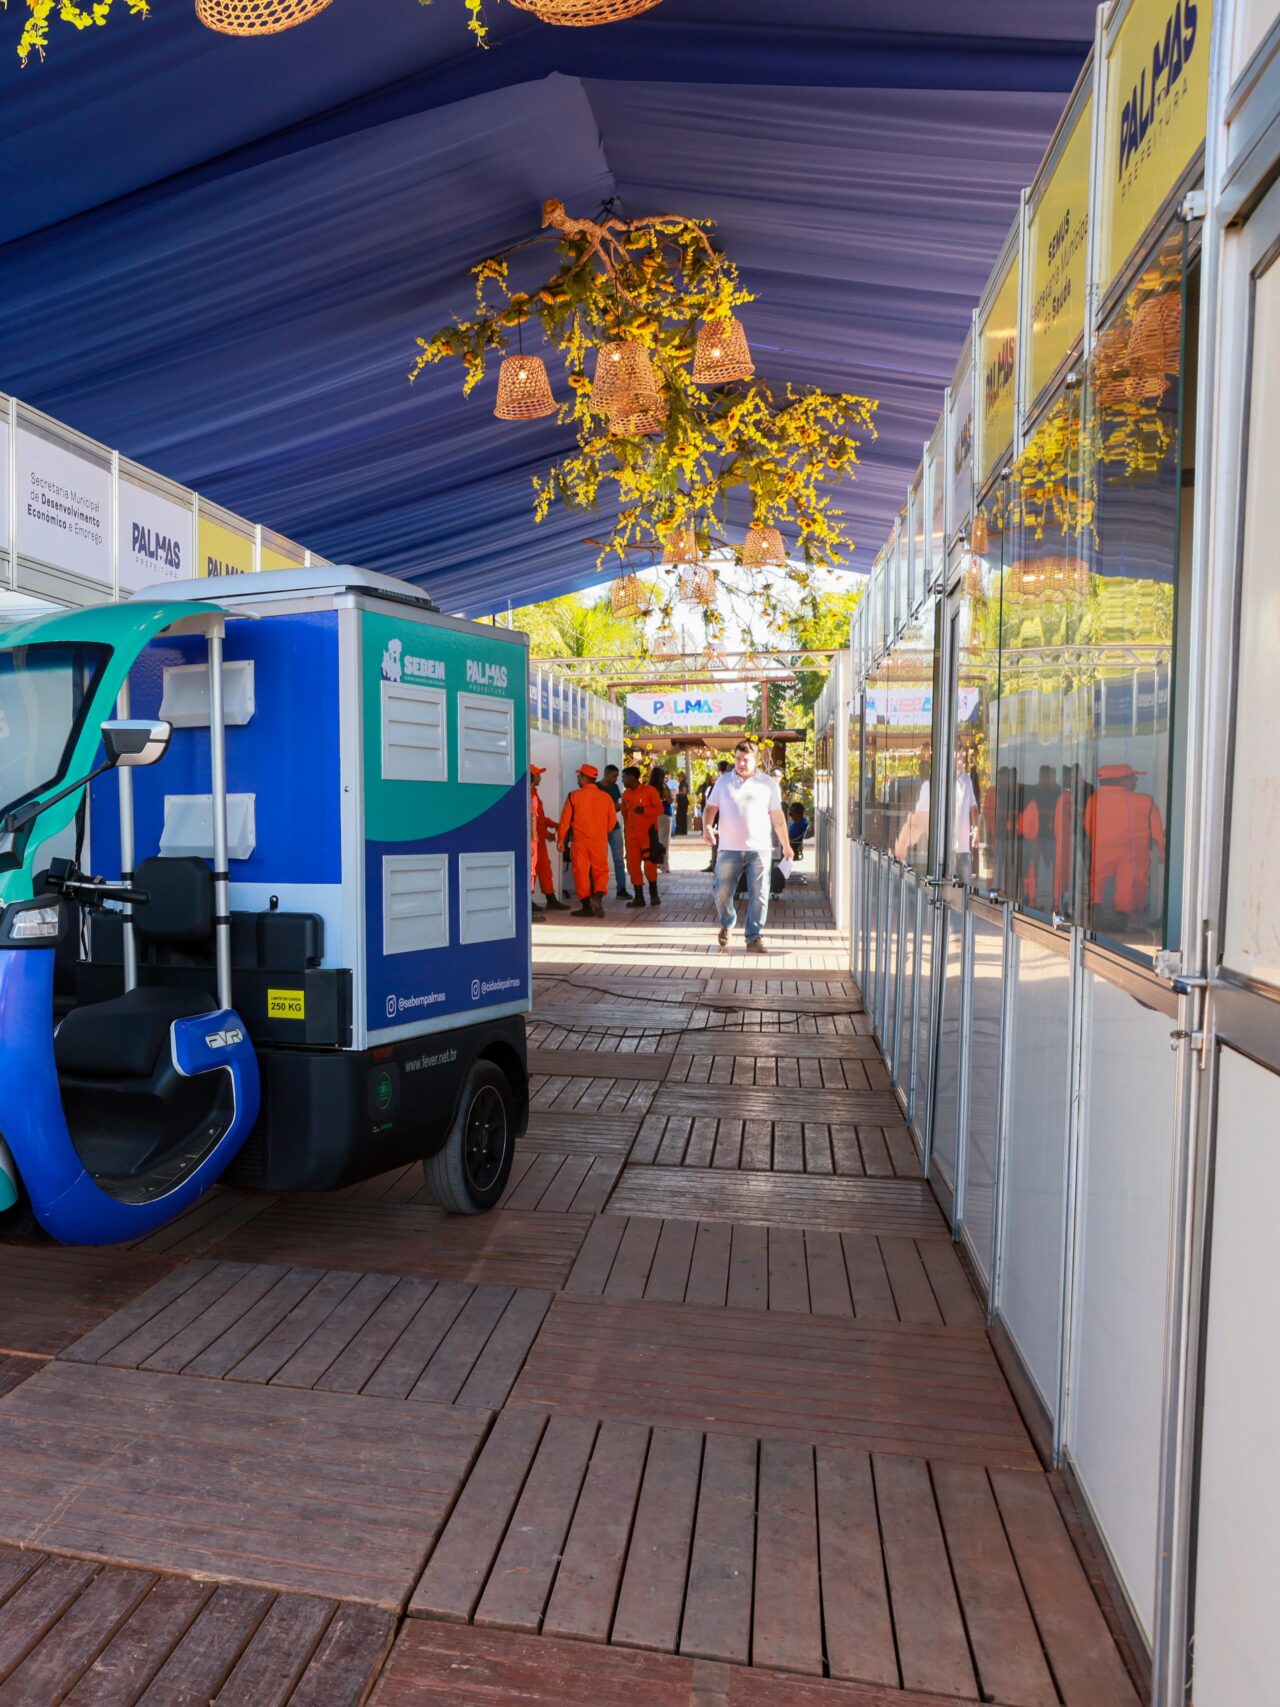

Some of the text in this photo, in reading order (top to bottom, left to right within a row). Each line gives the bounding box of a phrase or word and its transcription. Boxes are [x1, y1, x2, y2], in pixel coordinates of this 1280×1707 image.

[30, 471, 100, 513] Secretaria Municipal
[30, 489, 100, 528] de Desenvolvimento
[27, 503, 103, 546] Econômico e Emprego
[132, 521, 181, 570] PALMAS
[404, 655, 446, 680] SEBEM
[466, 659, 508, 688] PALMAS
[653, 699, 723, 715] PALMAS
[271, 1002, 302, 1012] 250 KG
[398, 992, 446, 1012] @sebempalmas
[404, 1048, 458, 1073] www.fever.net.br
